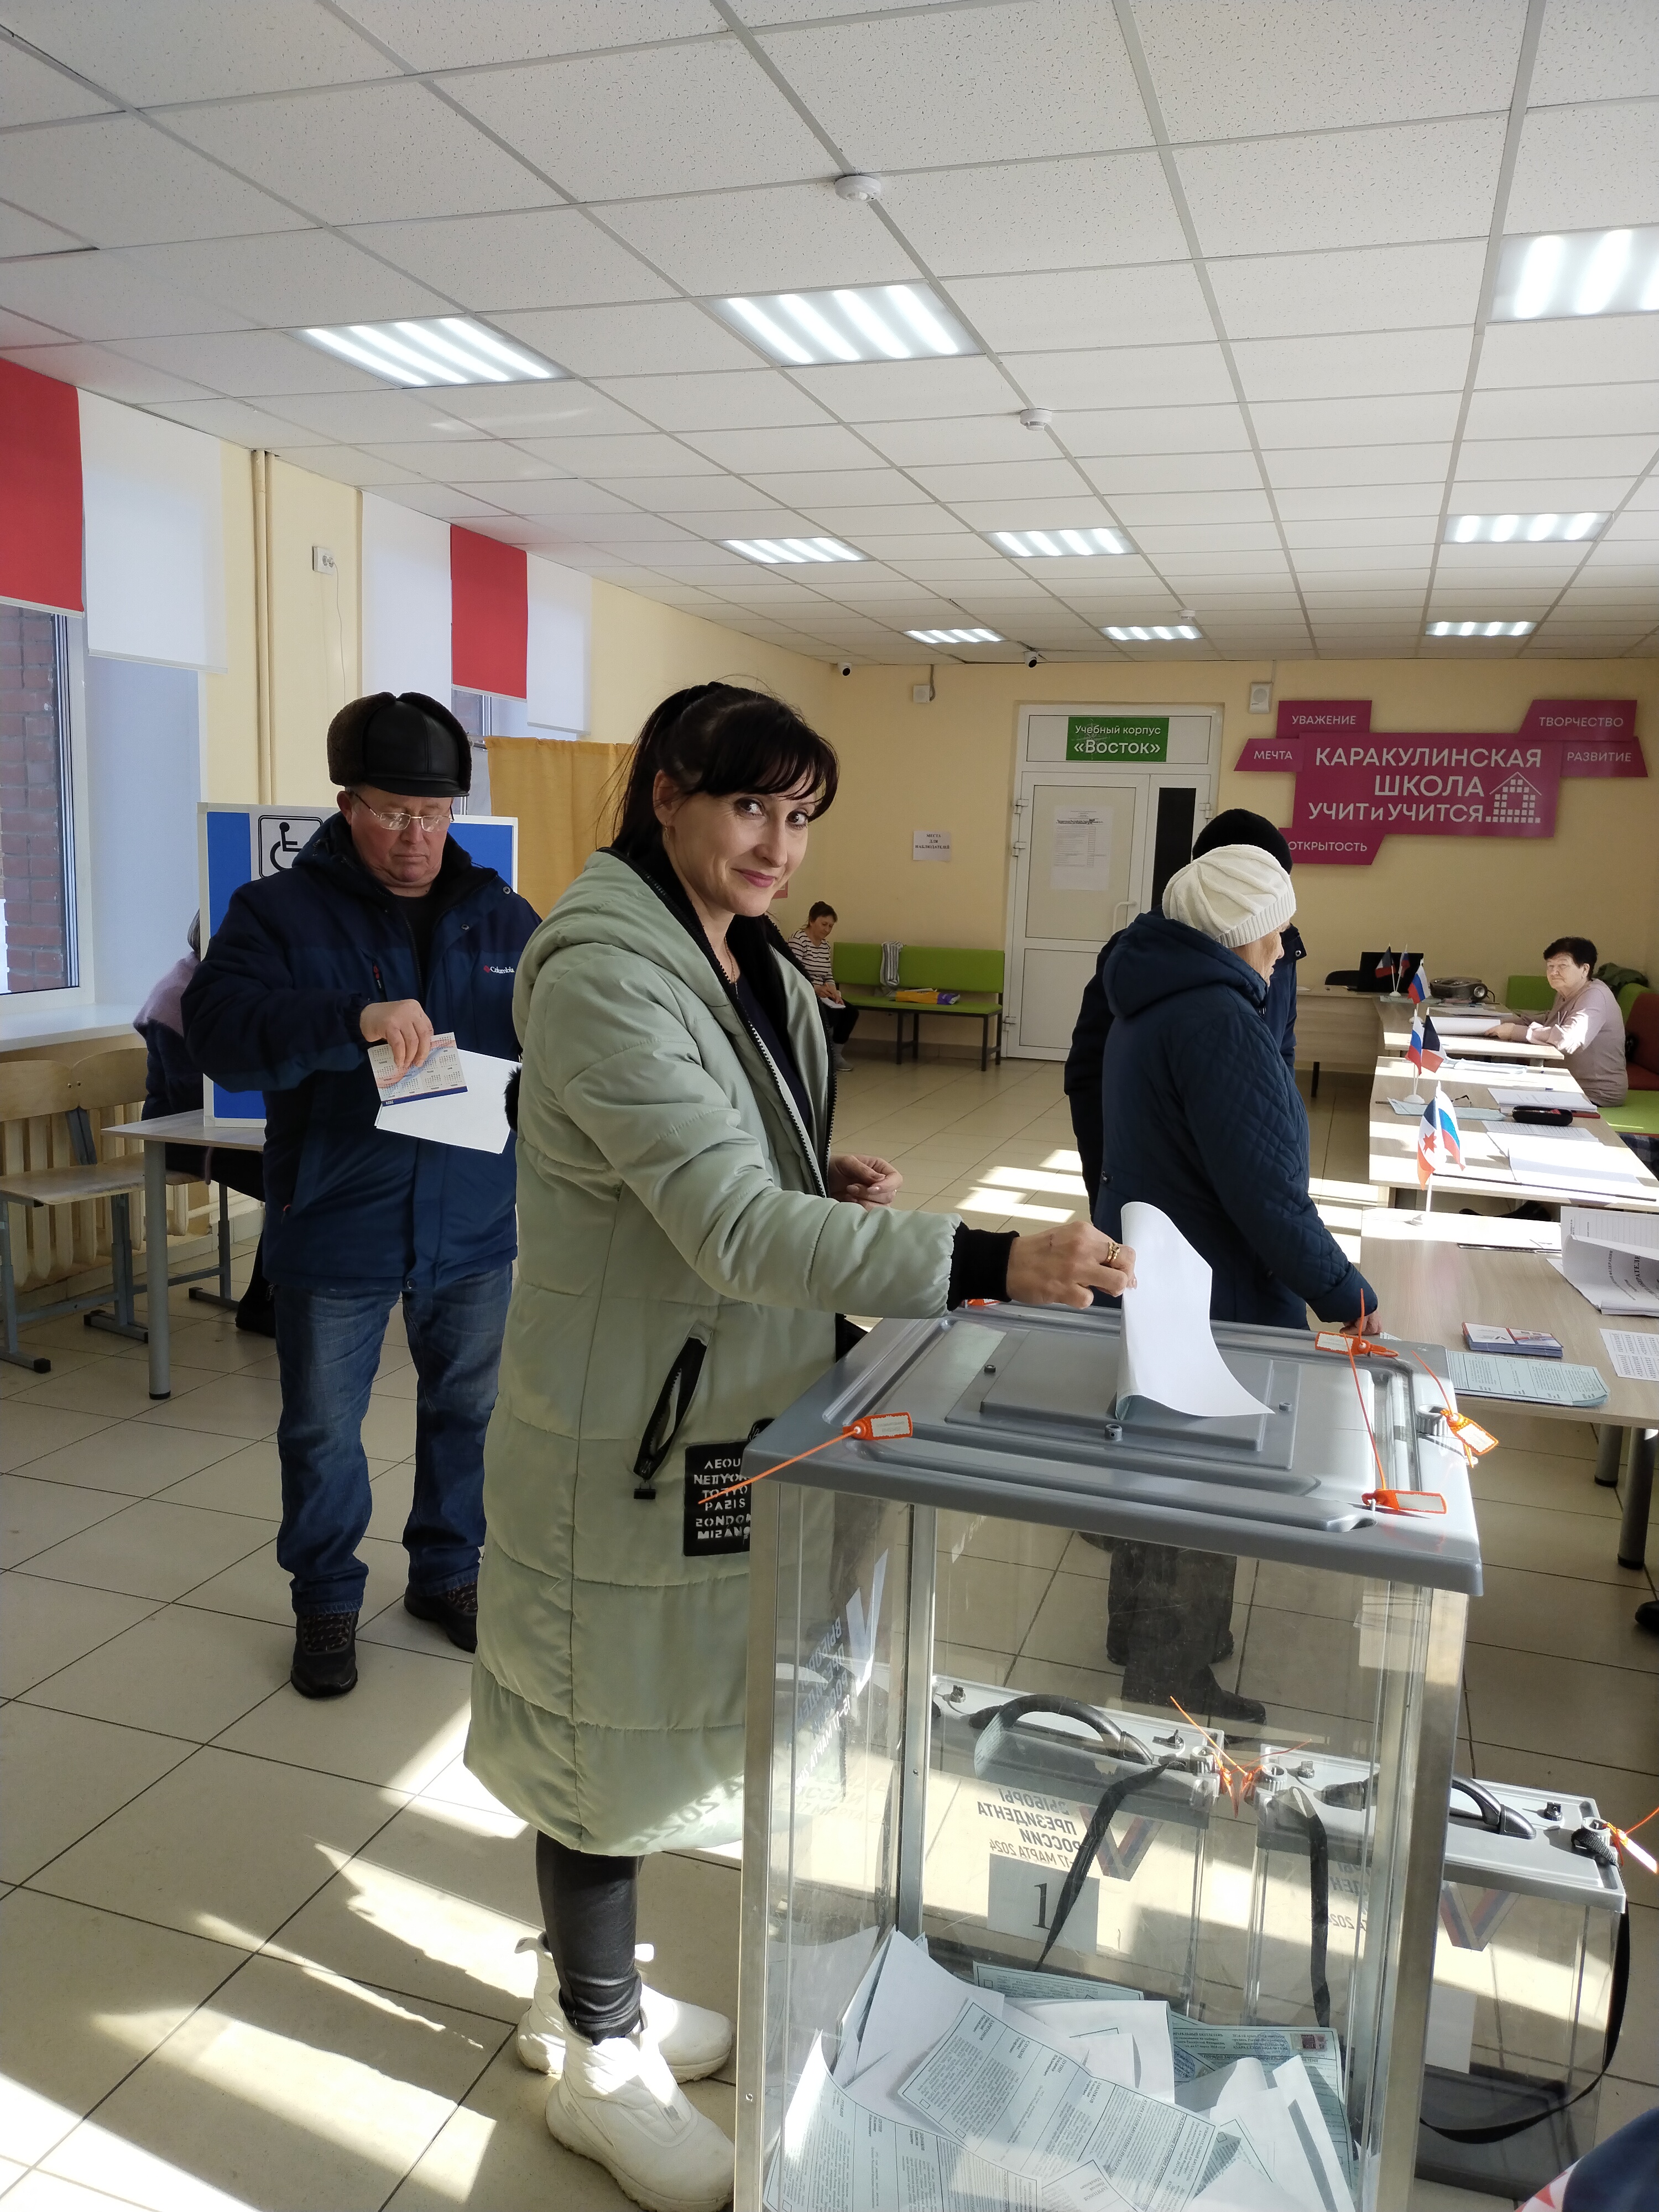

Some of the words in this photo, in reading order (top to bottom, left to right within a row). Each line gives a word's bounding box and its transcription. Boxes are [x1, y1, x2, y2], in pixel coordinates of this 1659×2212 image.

[1292, 715, 1356, 725] УВАЖЕНИЕ
[1540, 717, 1624, 727] ТВОРЧЕСТВО
[1075, 725, 1120, 734] Учебный
[1123, 727, 1161, 736] корпус
[1254, 750, 1292, 760] МЕЧТА
[1316, 747, 1542, 768] КАРАКУЛИНСКАЯ
[1567, 752, 1631, 762] РАЗВИТИЕ
[1374, 775, 1484, 797] ШКОЛА
[1308, 802, 1369, 821] УЧИТ
[1370, 807, 1384, 821] и
[1388, 804, 1484, 823] УЧИТСЯ
[1288, 841, 1367, 852] ОТКРЫТОСТЬ
[1032, 1882, 1051, 1931] 1
